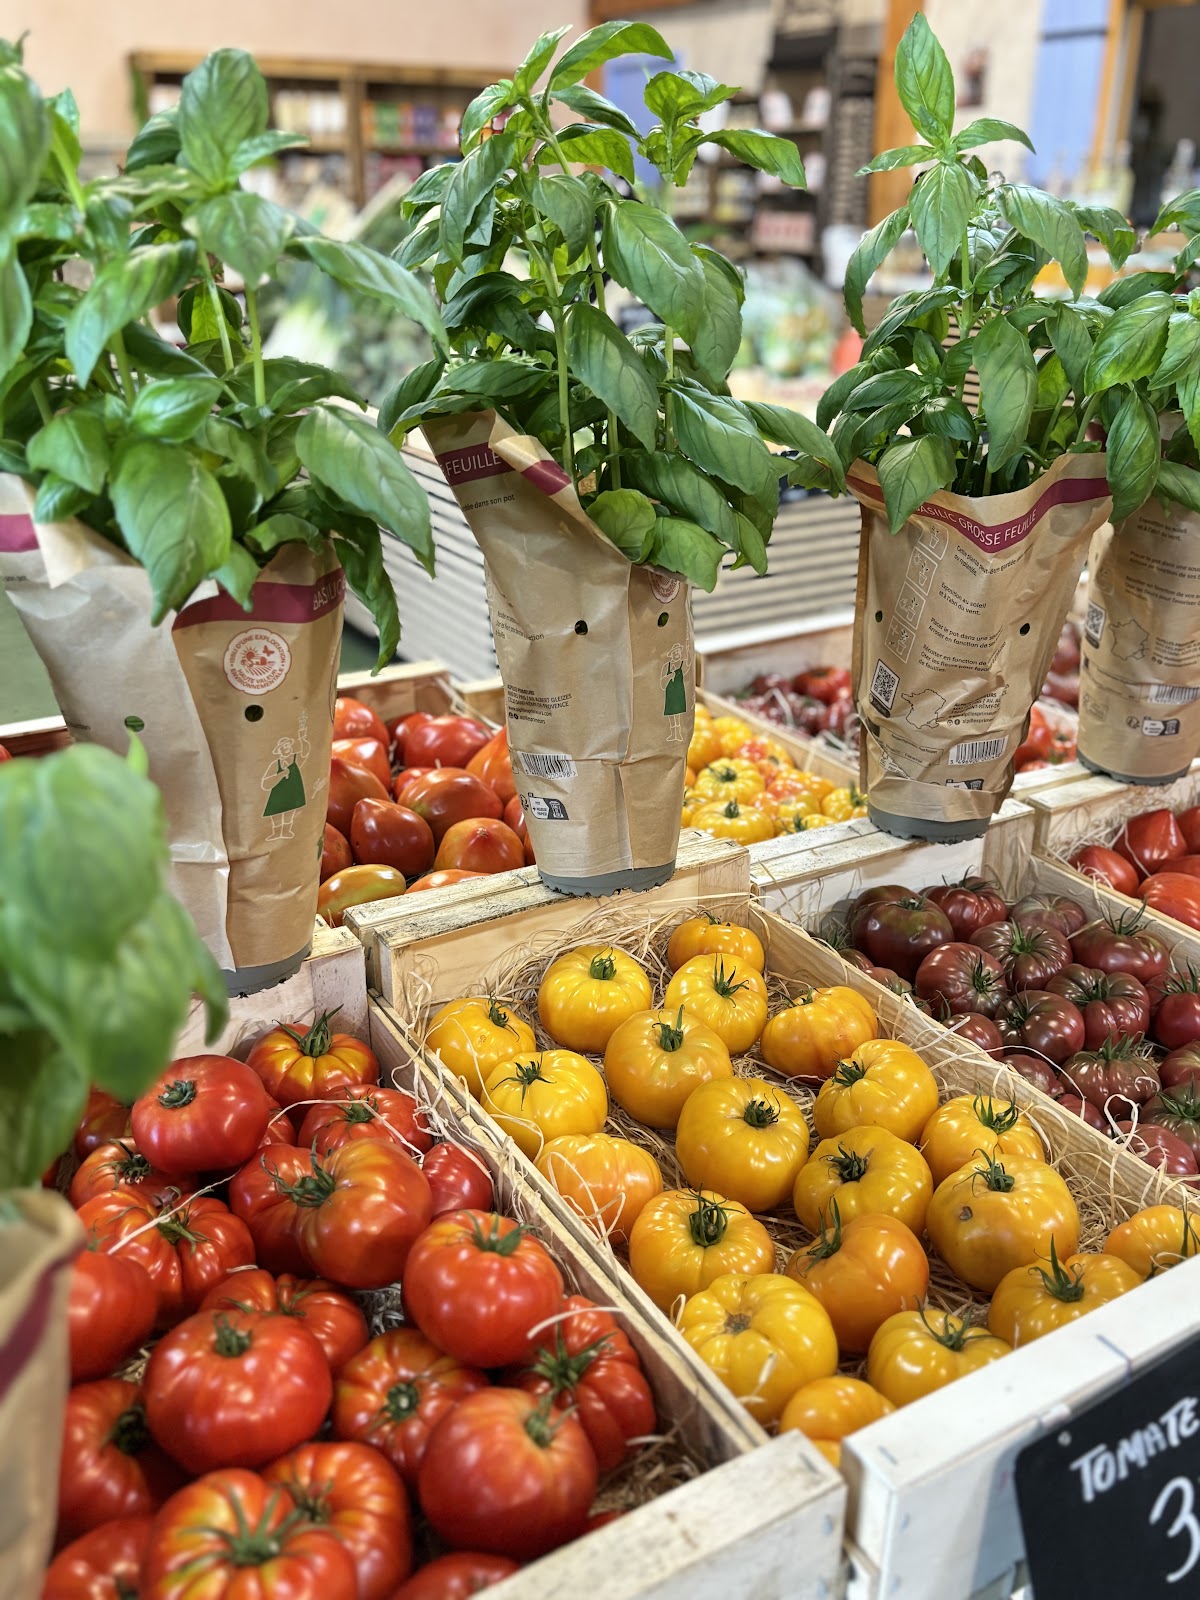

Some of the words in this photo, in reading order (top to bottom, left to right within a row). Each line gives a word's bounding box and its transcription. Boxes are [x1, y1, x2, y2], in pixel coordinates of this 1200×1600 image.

[446, 451, 501, 476] FEUILLE
[503, 494, 515, 503] pot
[958, 517, 1000, 546] GROSSE
[1004, 509, 1036, 541] FEUILLE
[313, 579, 342, 610] BASILIC
[941, 582, 962, 601] Exposition
[949, 630, 959, 638] pot
[953, 638, 978, 648] fonction
[254, 634, 286, 664] EXPLOITATION
[952, 656, 978, 665] fonction
[230, 668, 285, 689] ENVIRONNEMENTALE
[237, 669, 254, 684] HAUTE
[256, 669, 278, 684] VALEUR
[550, 693, 572, 703] GLEIZES
[1068, 1396, 1200, 1503] TOMATE
[1149, 1476, 1200, 1584] 3
